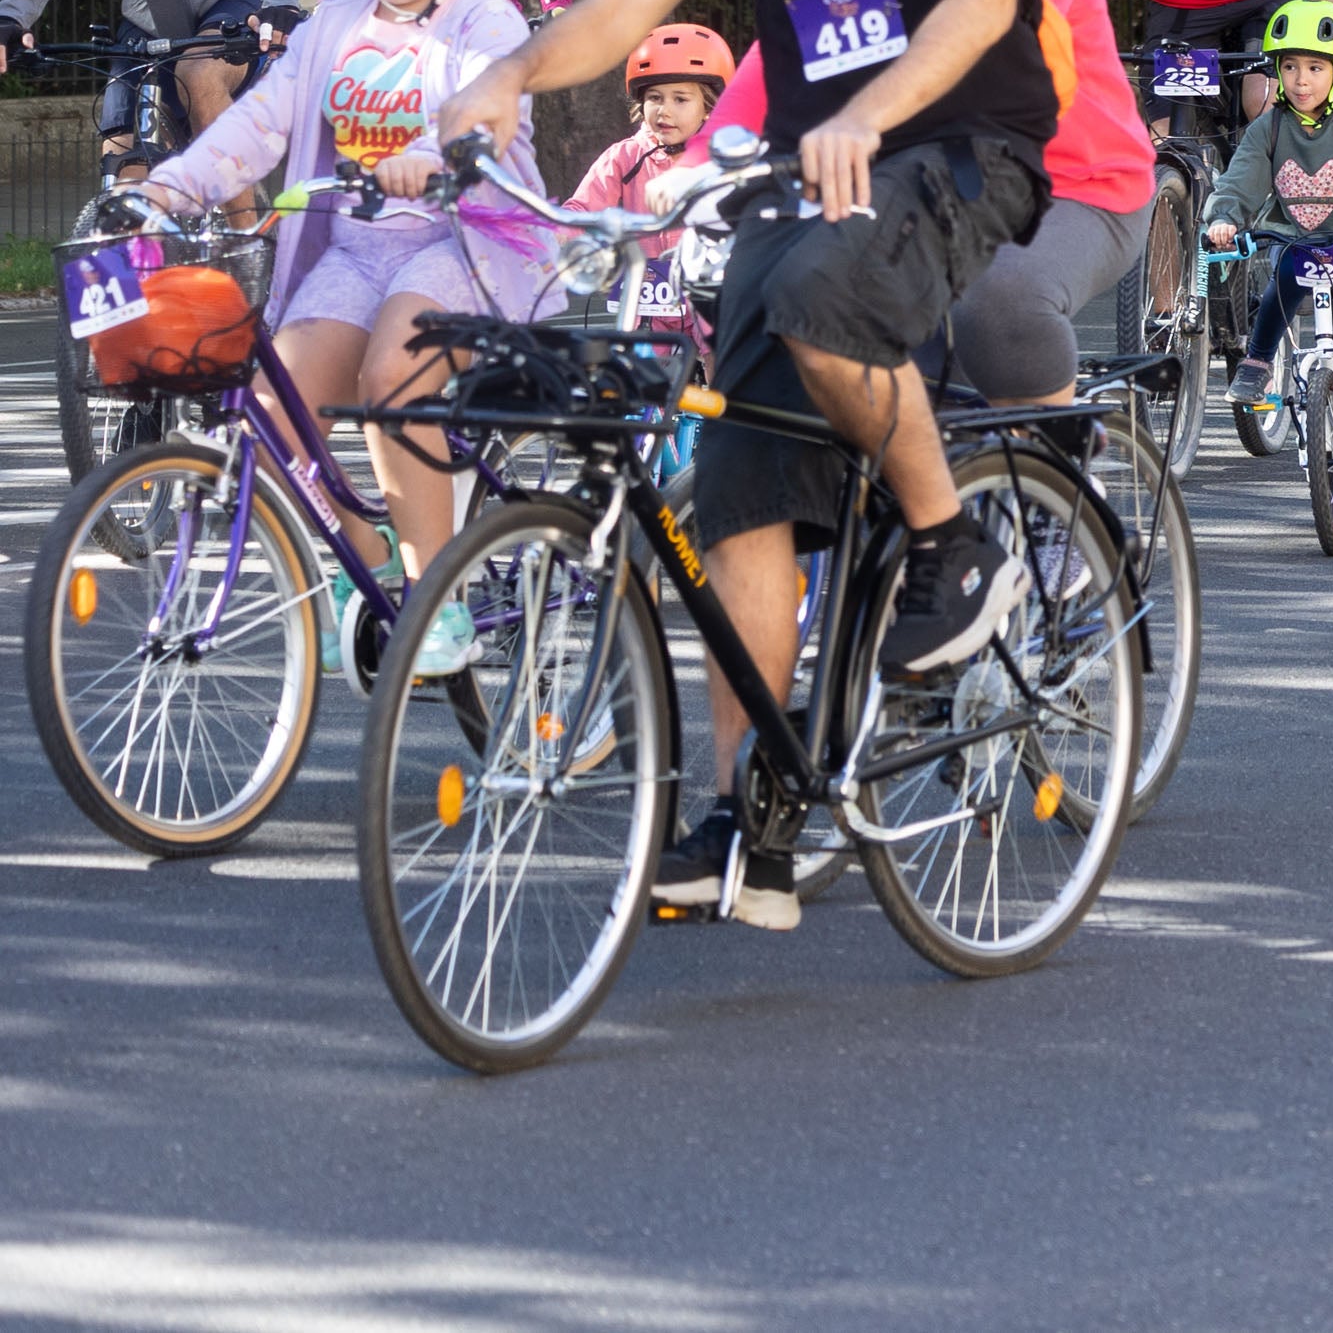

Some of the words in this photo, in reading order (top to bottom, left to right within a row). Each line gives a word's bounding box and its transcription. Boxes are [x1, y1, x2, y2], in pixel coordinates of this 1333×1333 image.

[815, 9, 889, 57] 419
[1164, 67, 1210, 86] 225
[329, 76, 422, 124] Chupa
[79, 276, 126, 318] 421
